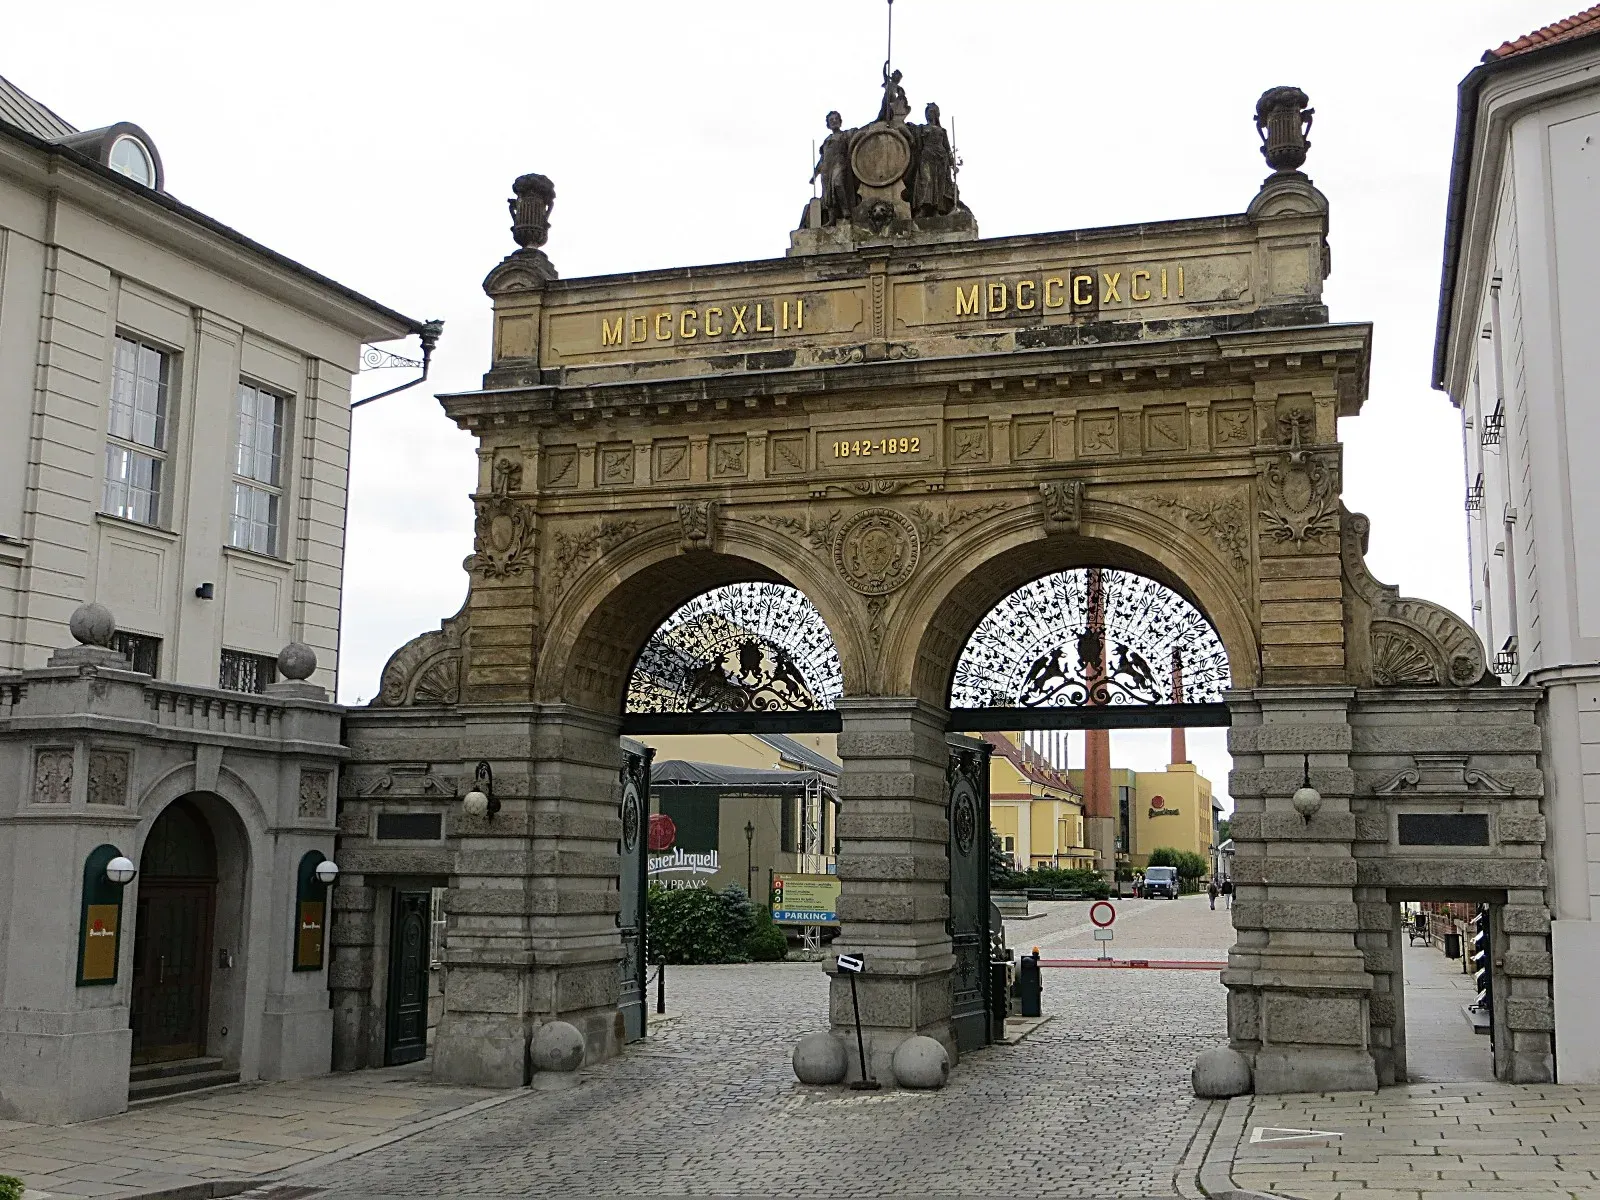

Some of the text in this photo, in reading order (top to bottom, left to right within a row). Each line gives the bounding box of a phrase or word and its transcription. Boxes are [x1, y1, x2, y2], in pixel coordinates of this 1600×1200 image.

[956, 265, 1184, 316] MDCCCXCII
[602, 300, 803, 346] MDCCCXLII
[832, 437, 920, 458] 1842-1892
[673, 846, 718, 874] Urquell
[784, 912, 827, 920] PARKING
